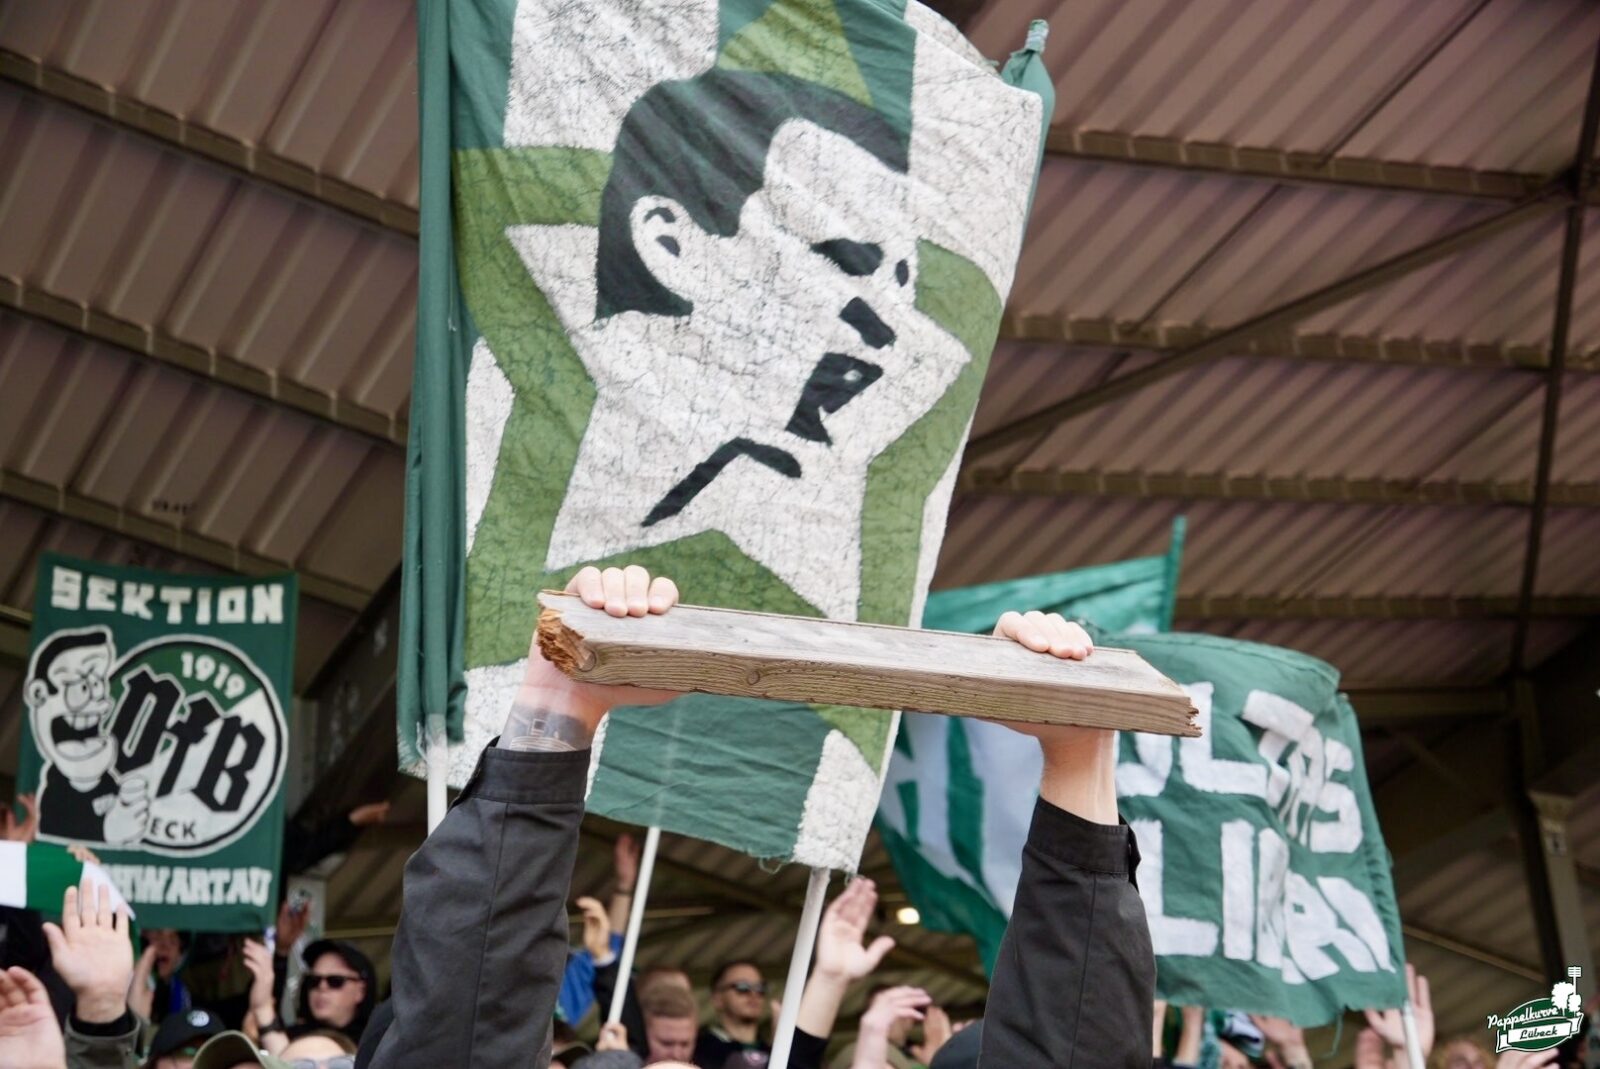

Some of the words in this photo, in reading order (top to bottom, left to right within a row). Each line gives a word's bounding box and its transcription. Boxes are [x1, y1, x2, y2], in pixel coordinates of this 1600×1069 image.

[51, 566, 284, 625] SEKTION
[181, 652, 247, 699] 1919
[104, 864, 273, 908] HWARTAU
